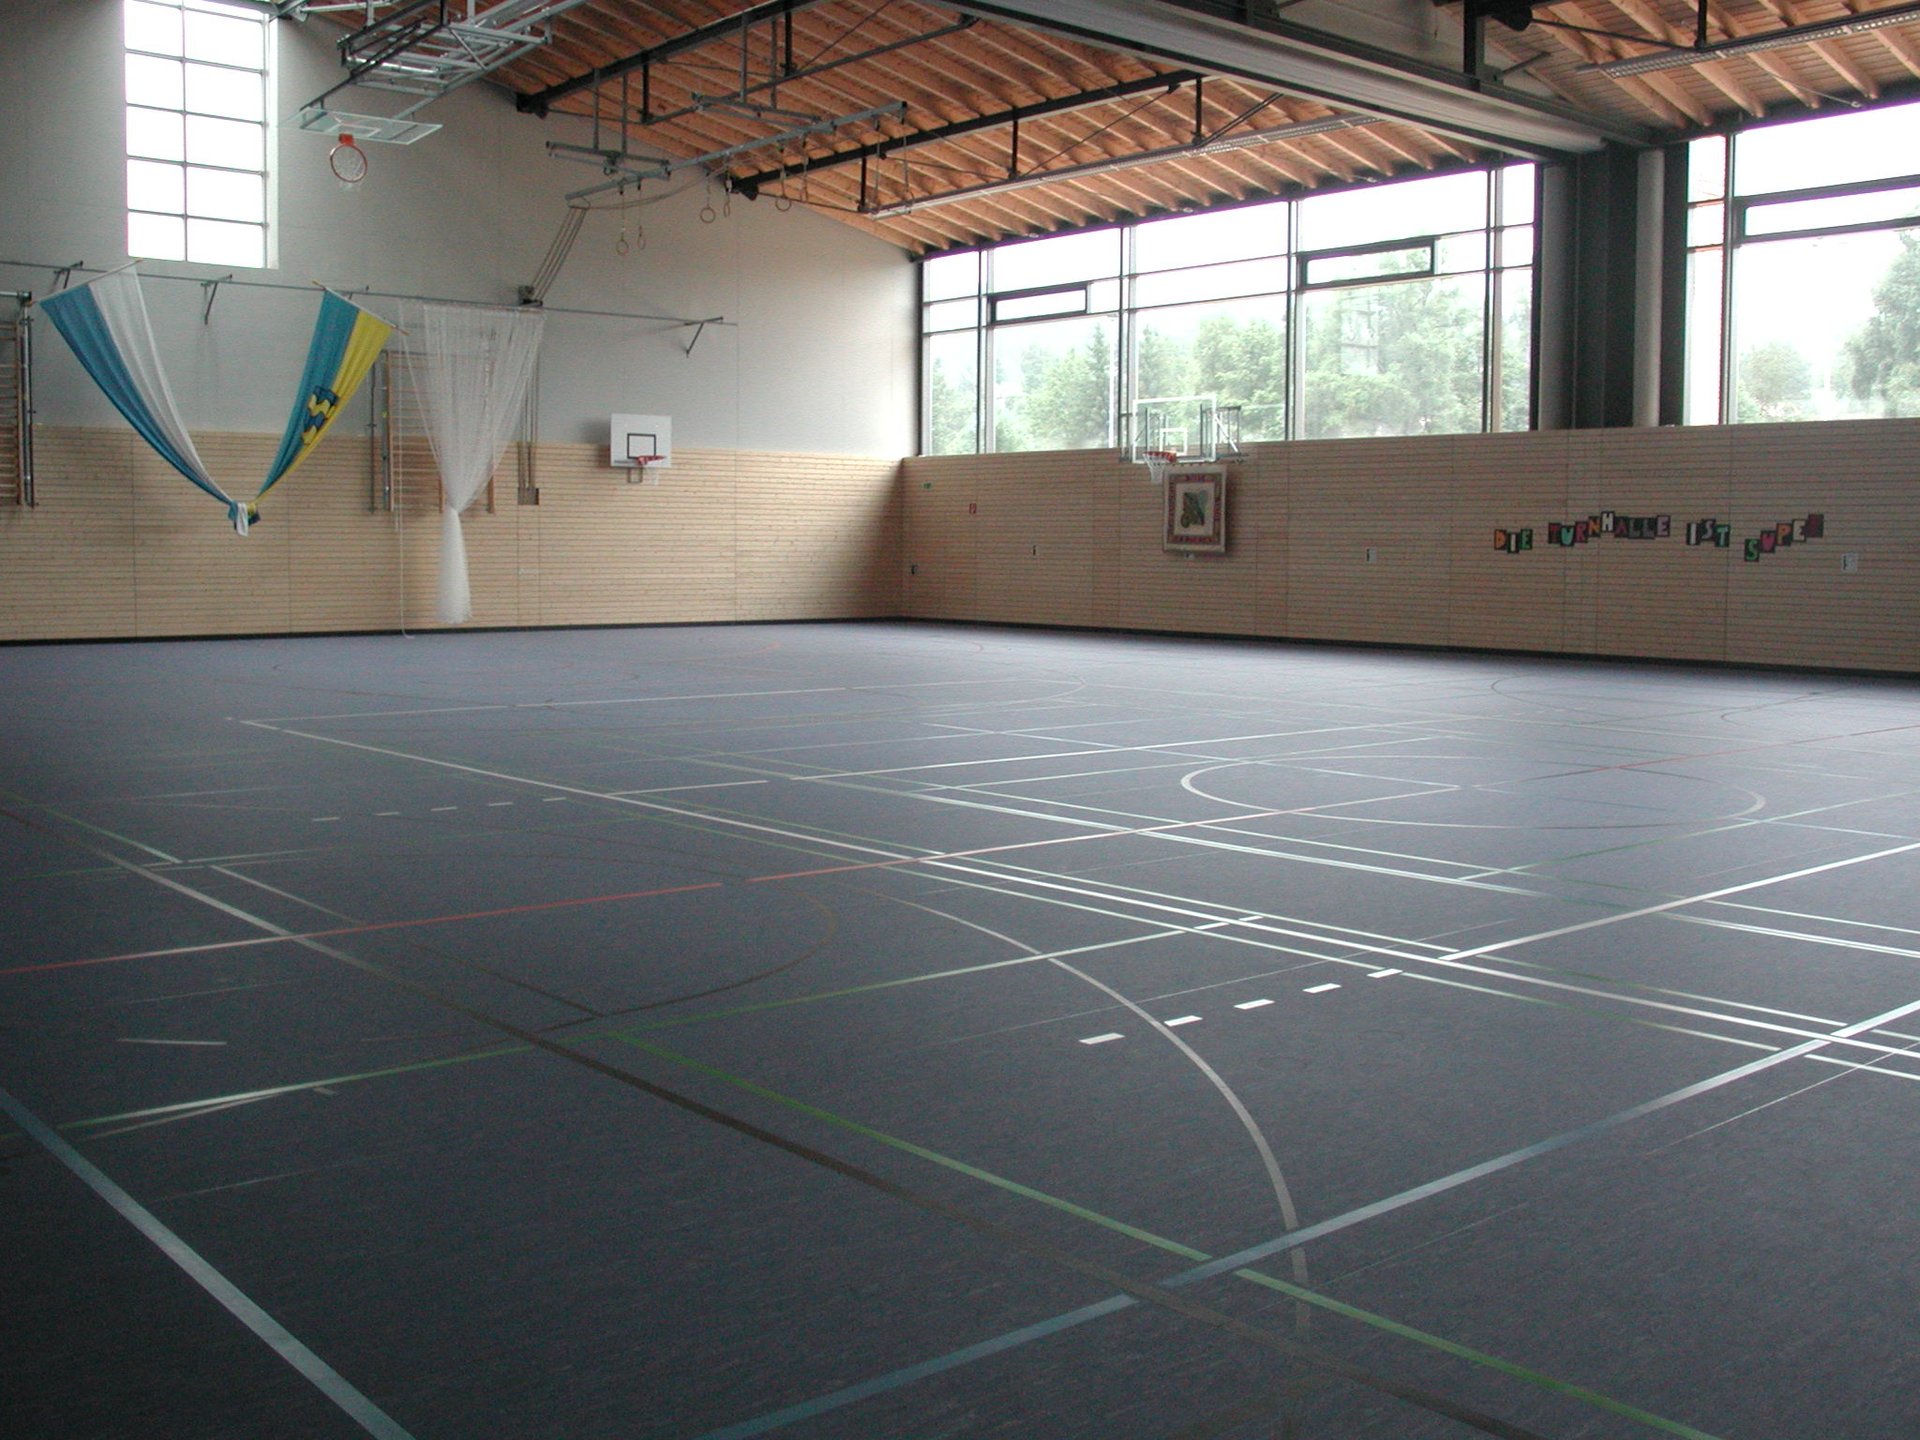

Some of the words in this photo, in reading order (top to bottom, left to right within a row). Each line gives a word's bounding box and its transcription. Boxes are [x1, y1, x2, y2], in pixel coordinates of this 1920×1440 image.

[1495, 529, 1532, 553] DIE
[1549, 511, 1670, 546] TURNHALLE
[1688, 519, 1730, 547] IST
